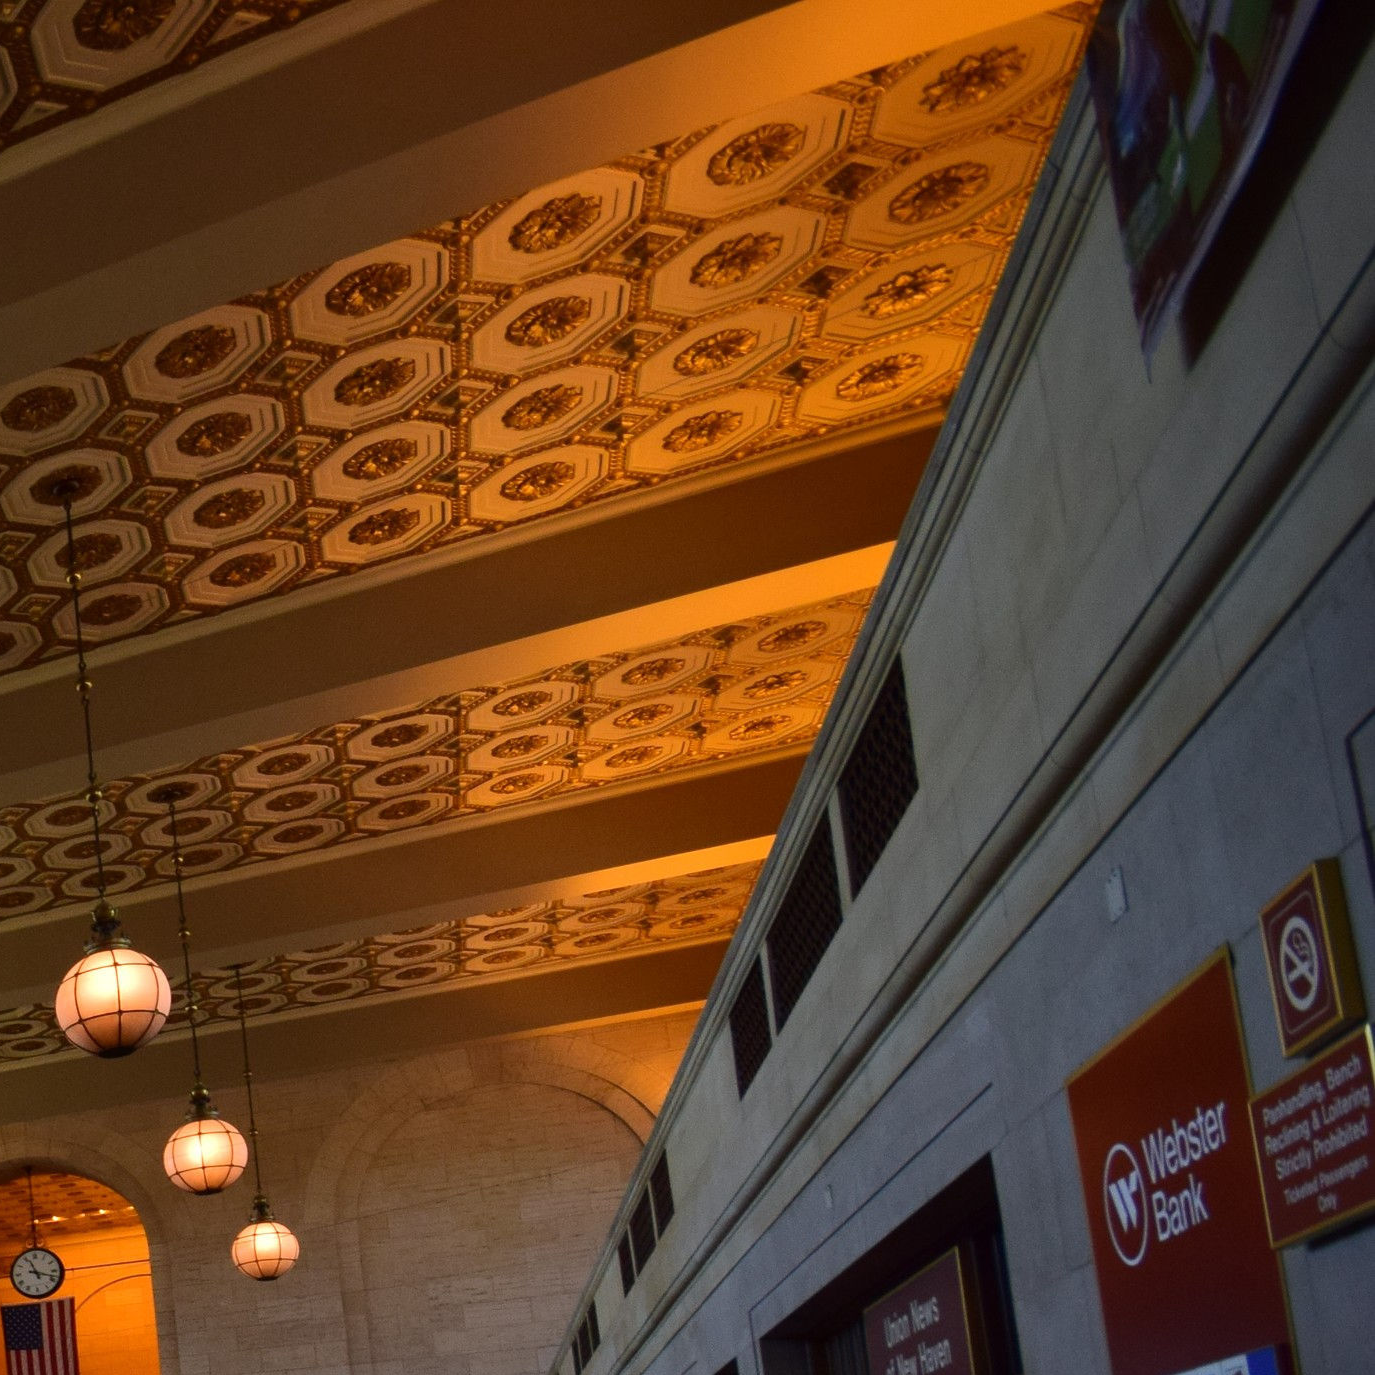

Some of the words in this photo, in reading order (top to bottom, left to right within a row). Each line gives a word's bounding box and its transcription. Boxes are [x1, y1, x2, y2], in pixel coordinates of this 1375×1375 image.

[1325, 1053, 1362, 1091] Bench
[1141, 1100, 1227, 1184] Webster
[1264, 1119, 1311, 1156] Reclining
[1311, 1109, 1322, 1131] &
[1321, 1085, 1370, 1126] Loitering
[1275, 1148, 1312, 1181] Strictly
[1313, 1114, 1369, 1160] Prohibited
[1152, 1173, 1210, 1242] Bank
[1284, 1175, 1319, 1206] Ticketed
[1317, 1193, 1338, 1214] Only
[883, 1312, 911, 1348] Union
[910, 1296, 940, 1333] News
[918, 1339, 952, 1375] Haven
